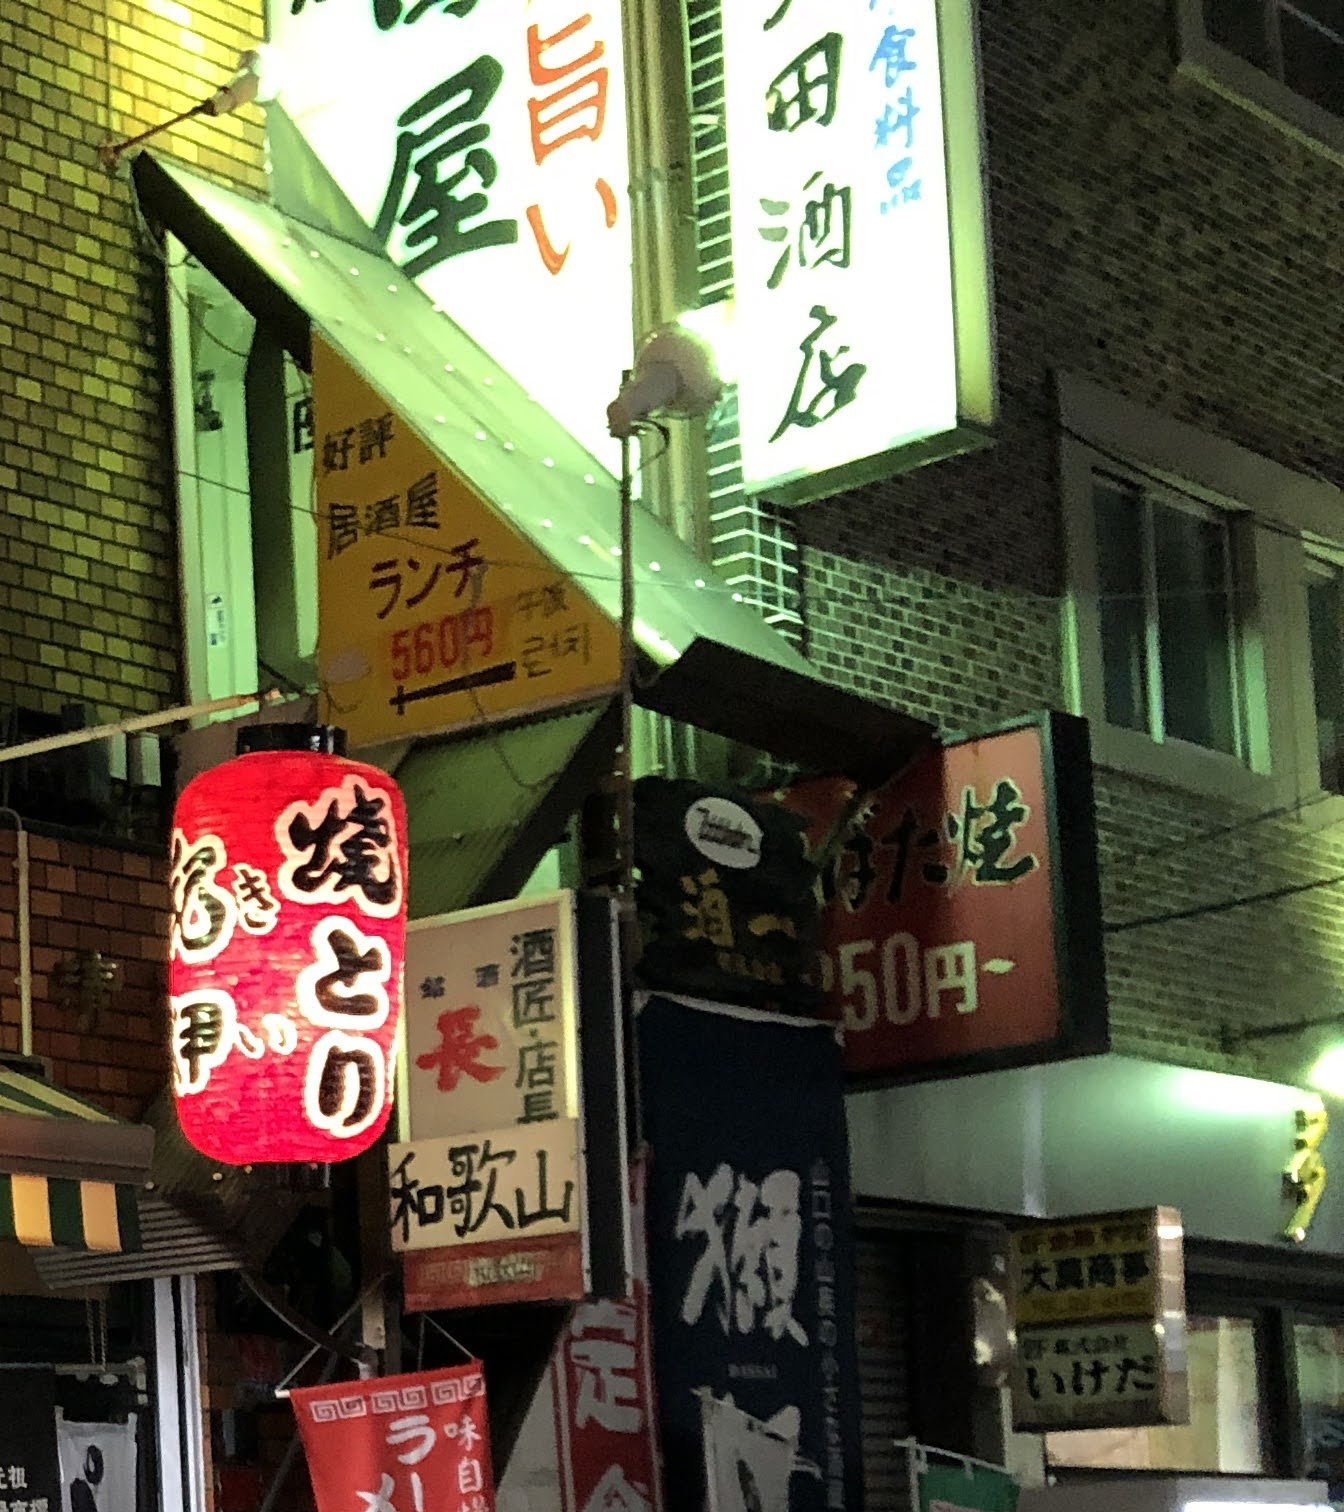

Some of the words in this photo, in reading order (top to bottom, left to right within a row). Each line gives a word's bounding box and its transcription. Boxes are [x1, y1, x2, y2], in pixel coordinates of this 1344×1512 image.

[867, 0, 925, 213] 食料品
[762, 0, 868, 443] 田酒店
[327, 472, 440, 560] 居酒屋
[369, 537, 482, 619] ランチ
[390, 607, 494, 681] 560円
[288, 783, 396, 1128] 焼とり
[416, 1004, 506, 1092] 長
[392, 1139, 574, 1242] 和歌山
